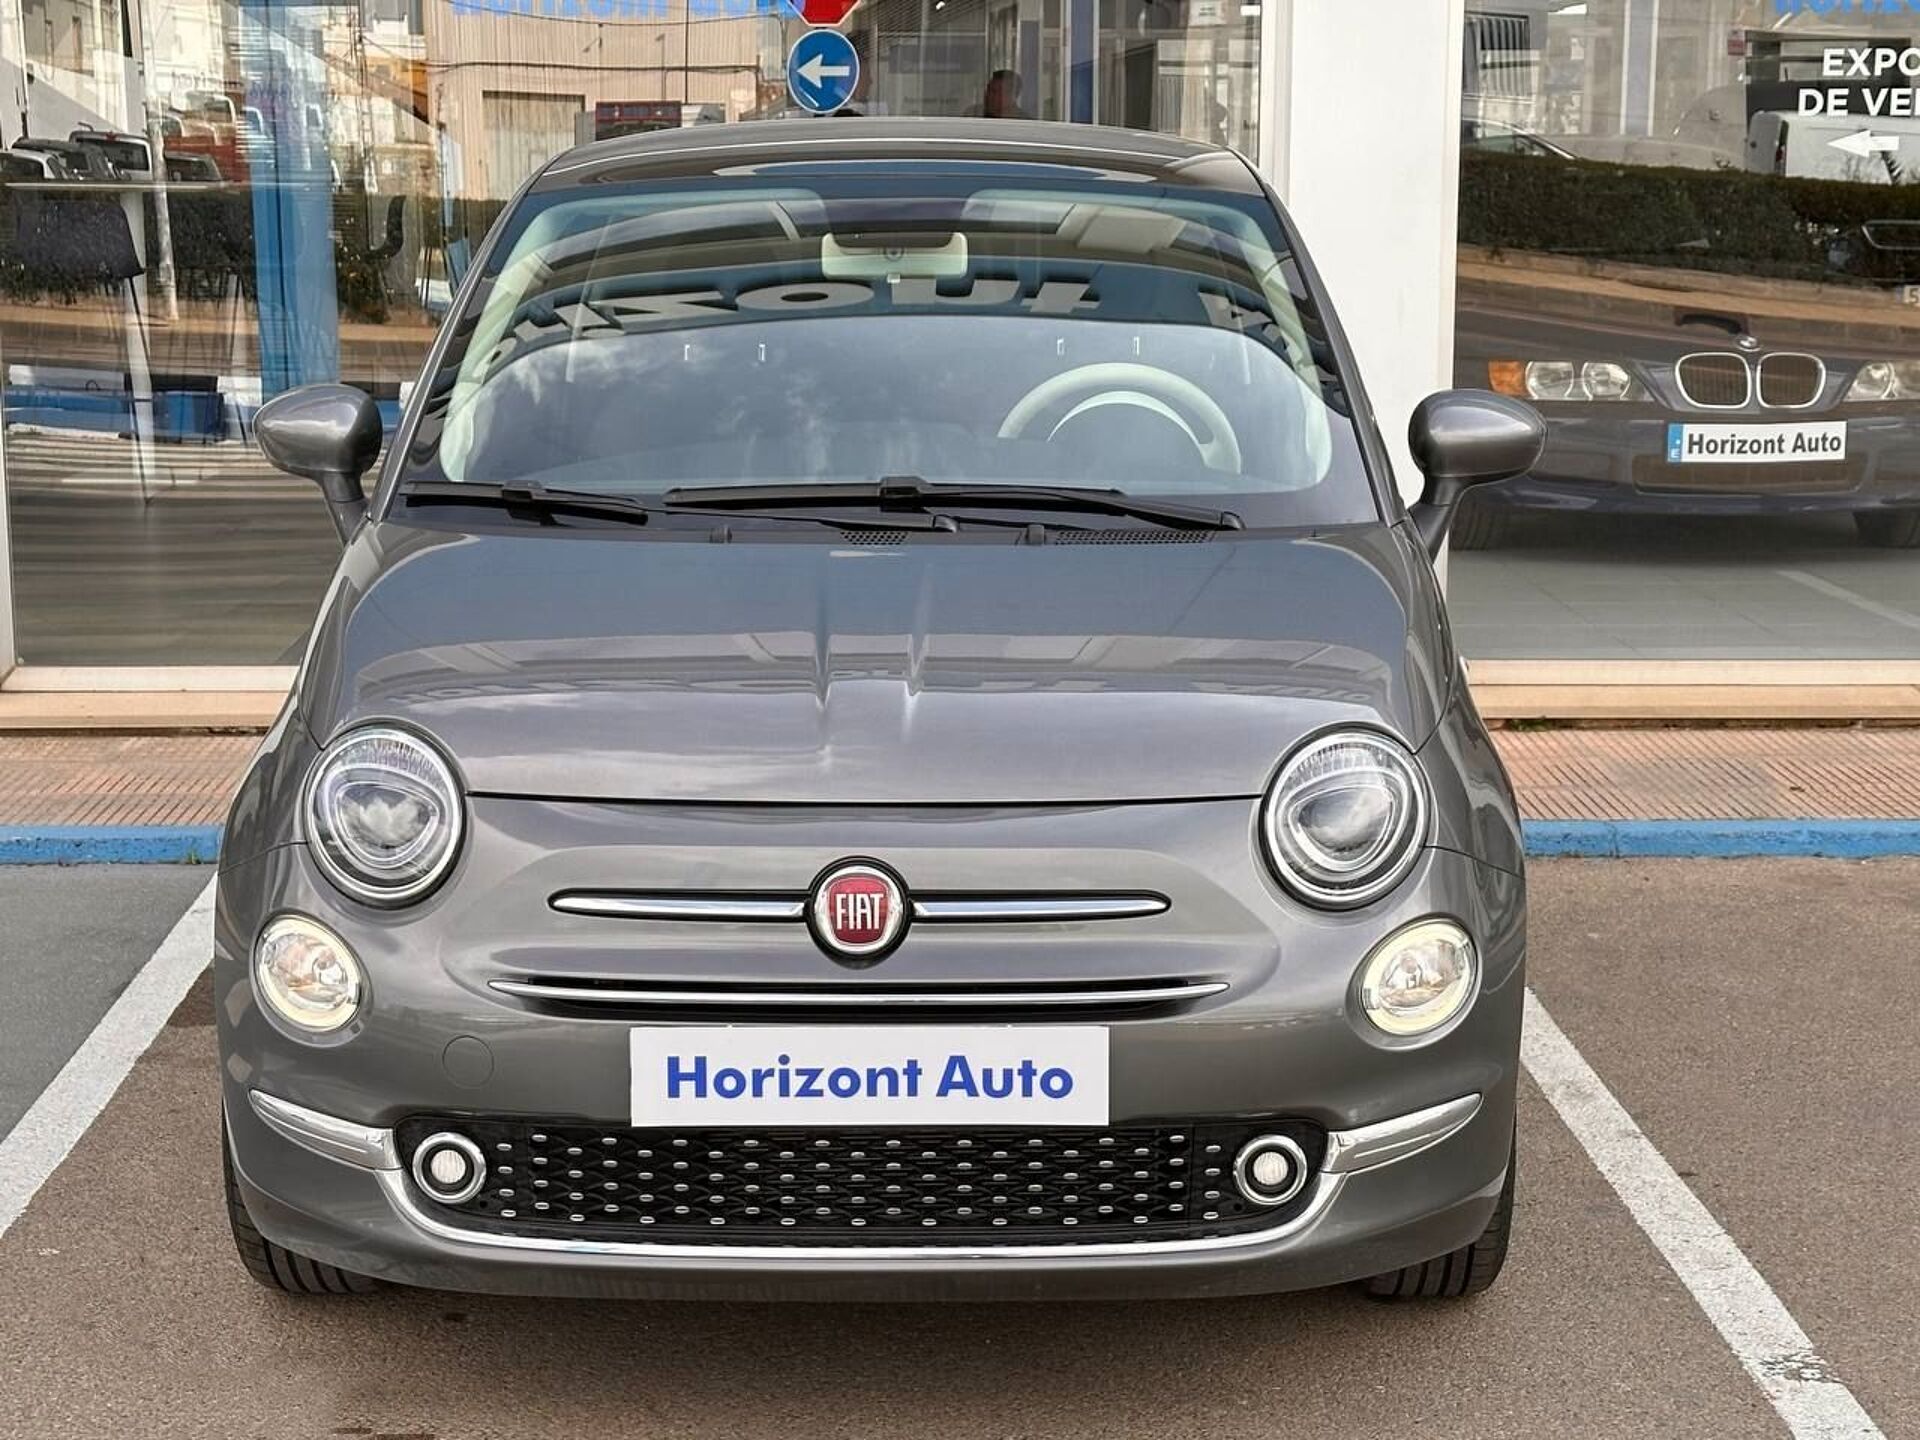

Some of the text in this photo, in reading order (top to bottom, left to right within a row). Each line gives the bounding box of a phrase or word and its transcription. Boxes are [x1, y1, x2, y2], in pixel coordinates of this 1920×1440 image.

[1798, 88, 1920, 117] DE VE
[1687, 432, 1842, 454] Horizont Auto
[836, 893, 884, 930] FIAT
[666, 1054, 1074, 1099] Horizont Auto
